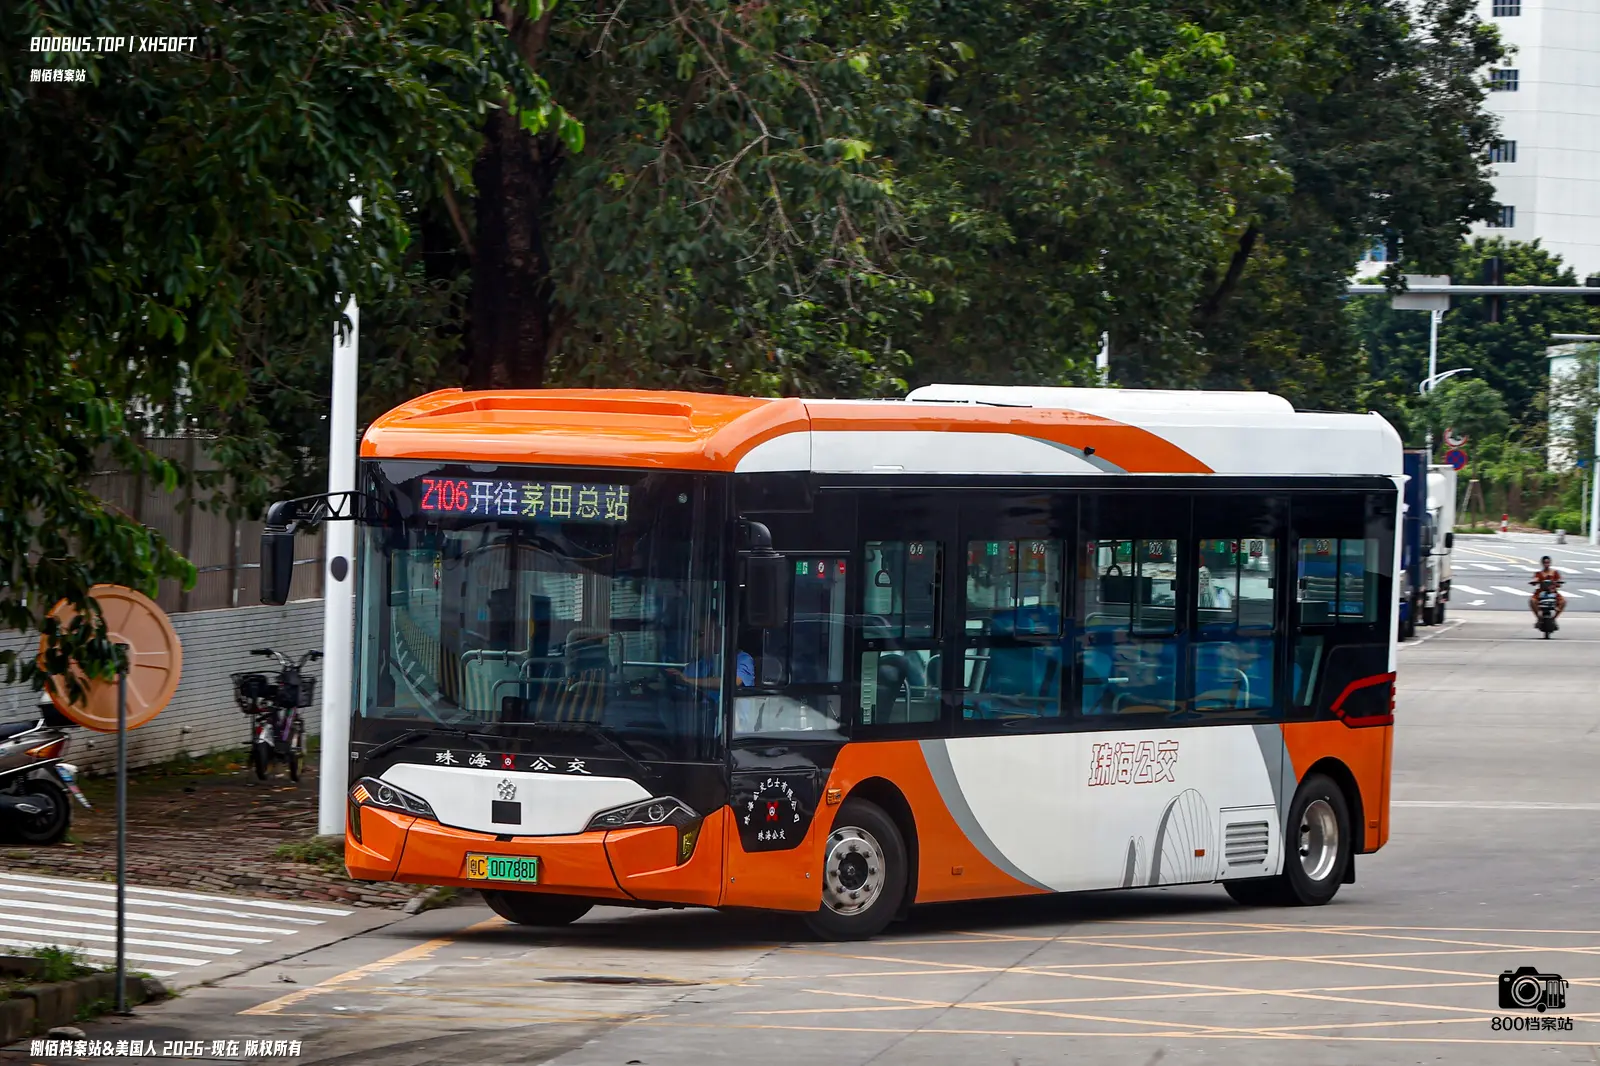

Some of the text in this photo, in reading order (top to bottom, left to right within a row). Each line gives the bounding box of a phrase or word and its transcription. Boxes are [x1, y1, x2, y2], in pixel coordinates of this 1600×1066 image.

[1088, 739, 1179, 786] 珠海公交
[757, 829, 786, 841] 珠海公交
